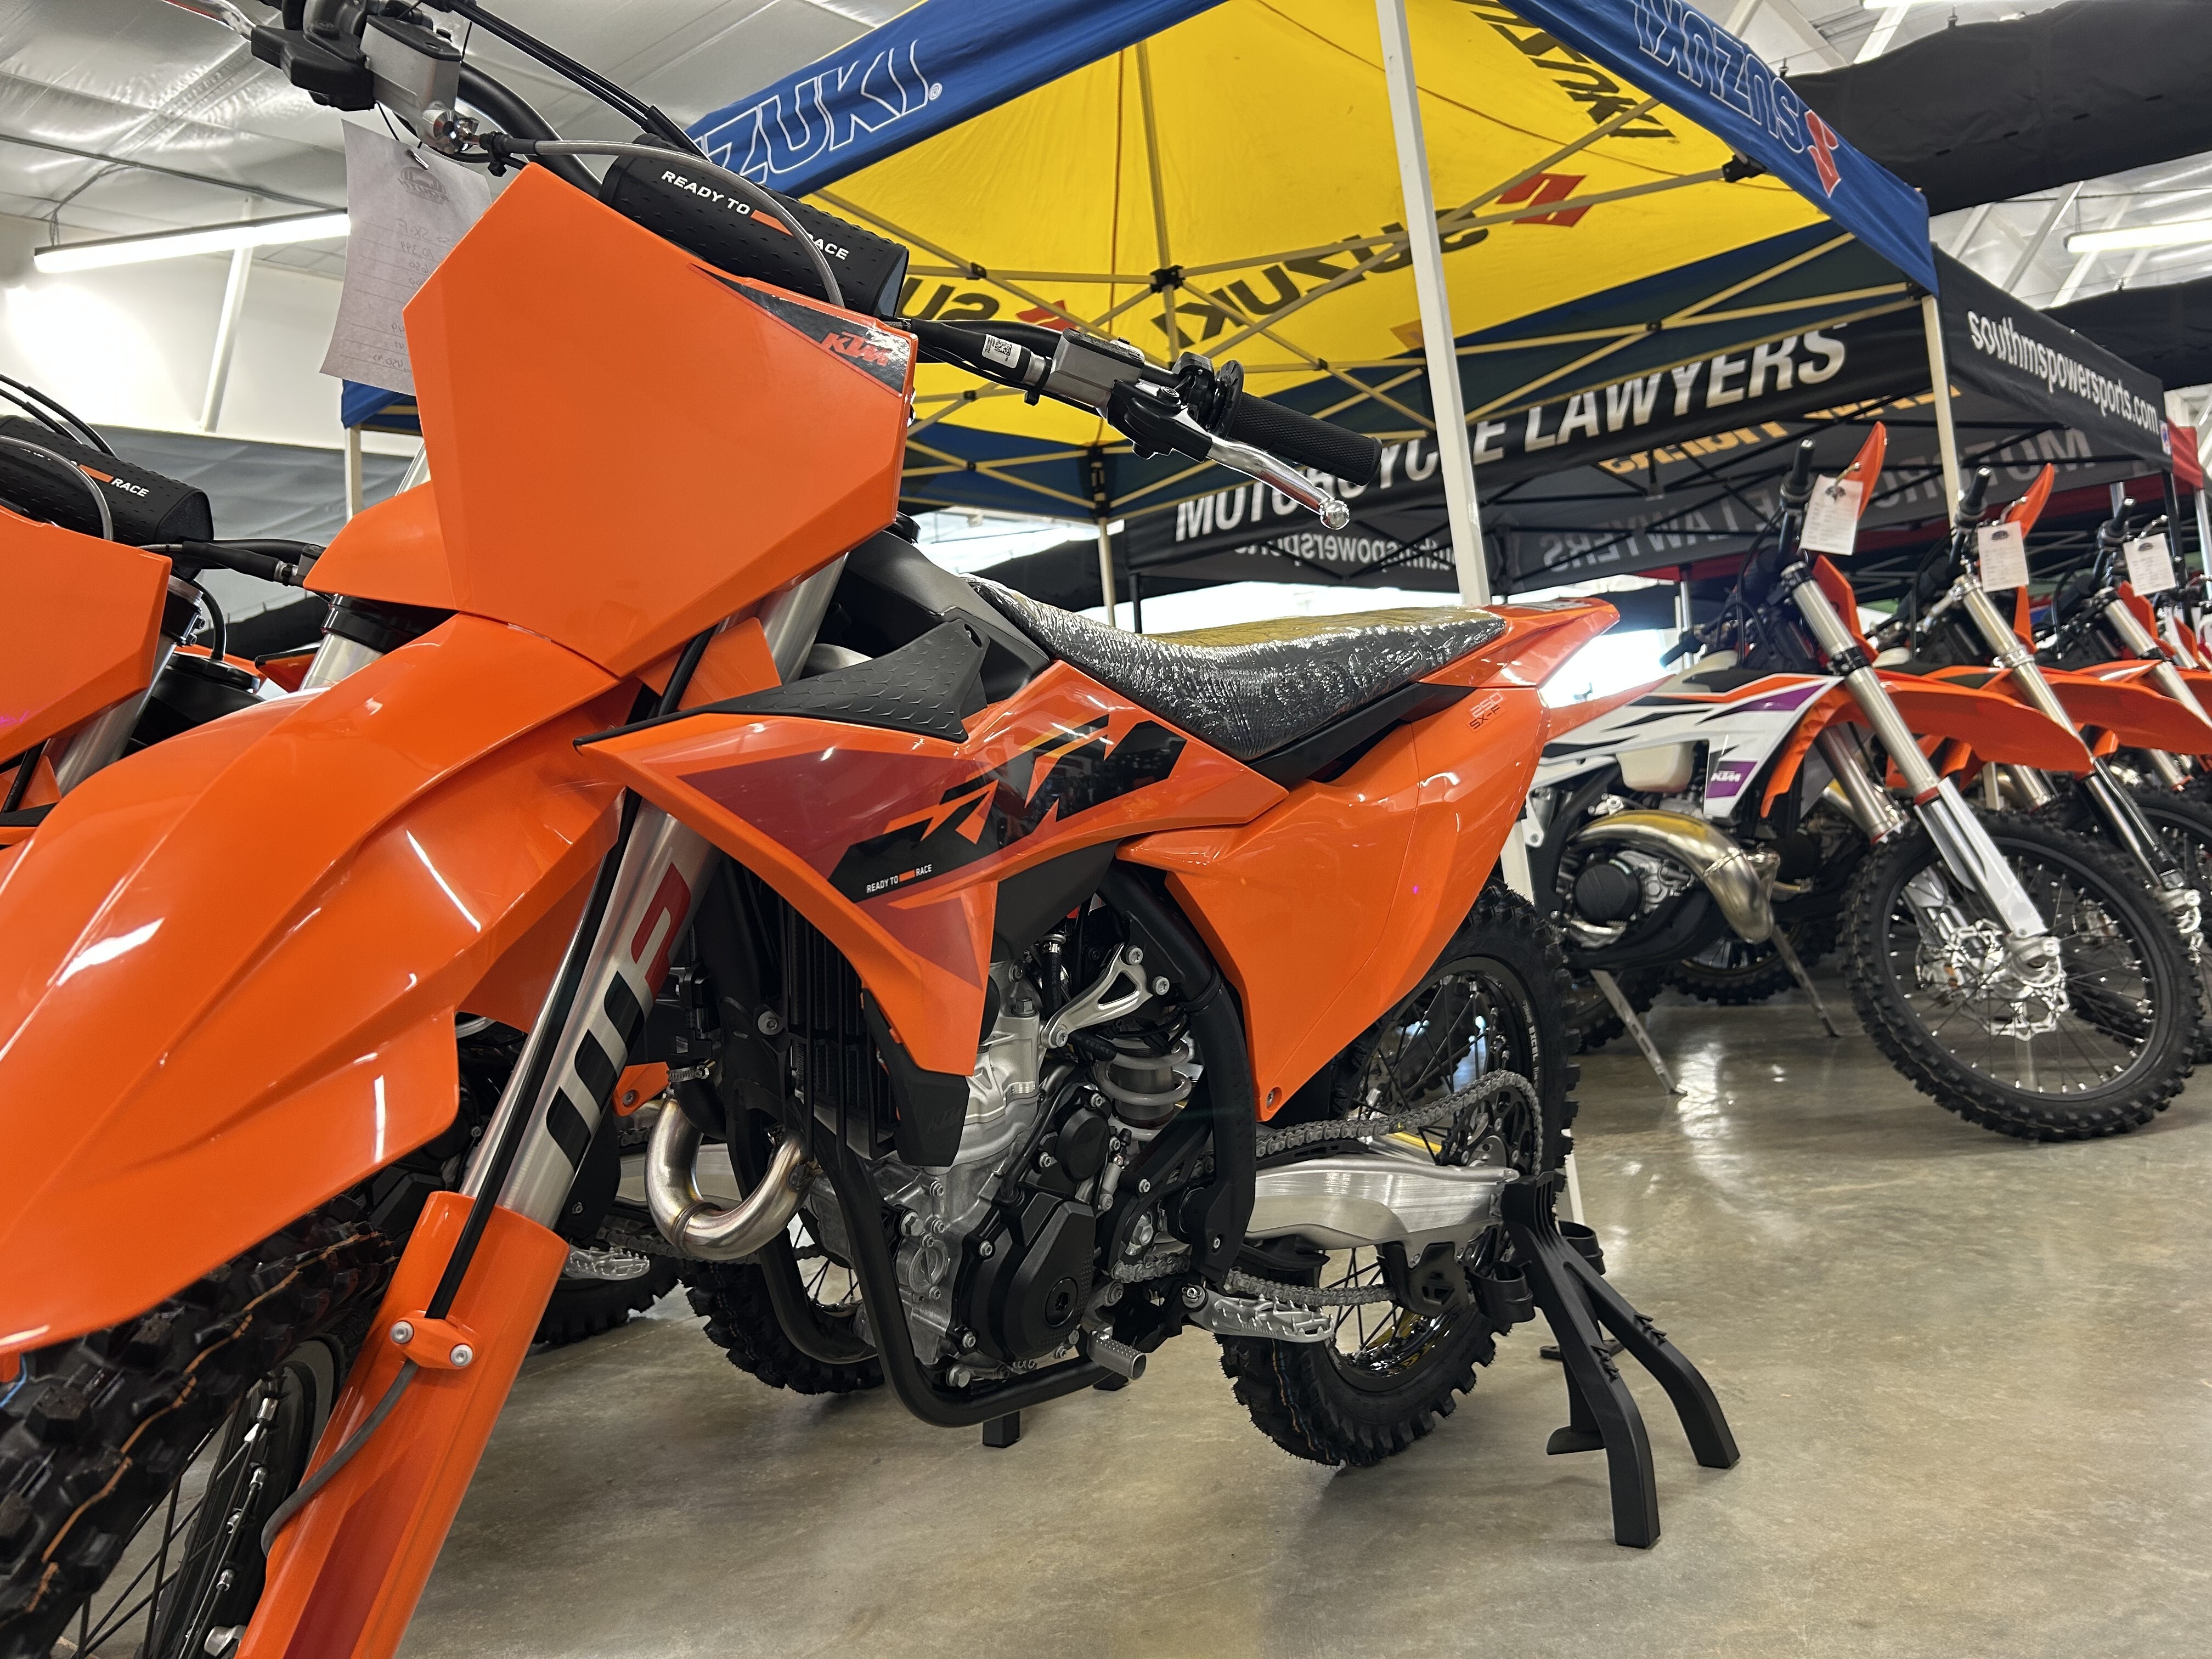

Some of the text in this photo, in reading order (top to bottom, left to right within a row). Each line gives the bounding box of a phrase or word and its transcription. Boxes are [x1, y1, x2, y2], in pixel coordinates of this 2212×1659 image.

[695, 40, 930, 185] ZUKI
[661, 171, 724, 202] READY
[727, 198, 751, 215] TO
[822, 331, 893, 367] KTM
[1525, 323, 1848, 452] LAWYERS
[1968, 310, 2159, 435] southmspowersports.com
[111, 478, 149, 497] RACE
[1469, 691, 1504, 718] 250
[1469, 704, 1501, 730] SX-F
[1711, 770, 1741, 782] KTM
[866, 864, 932, 893] READY TO RACE
